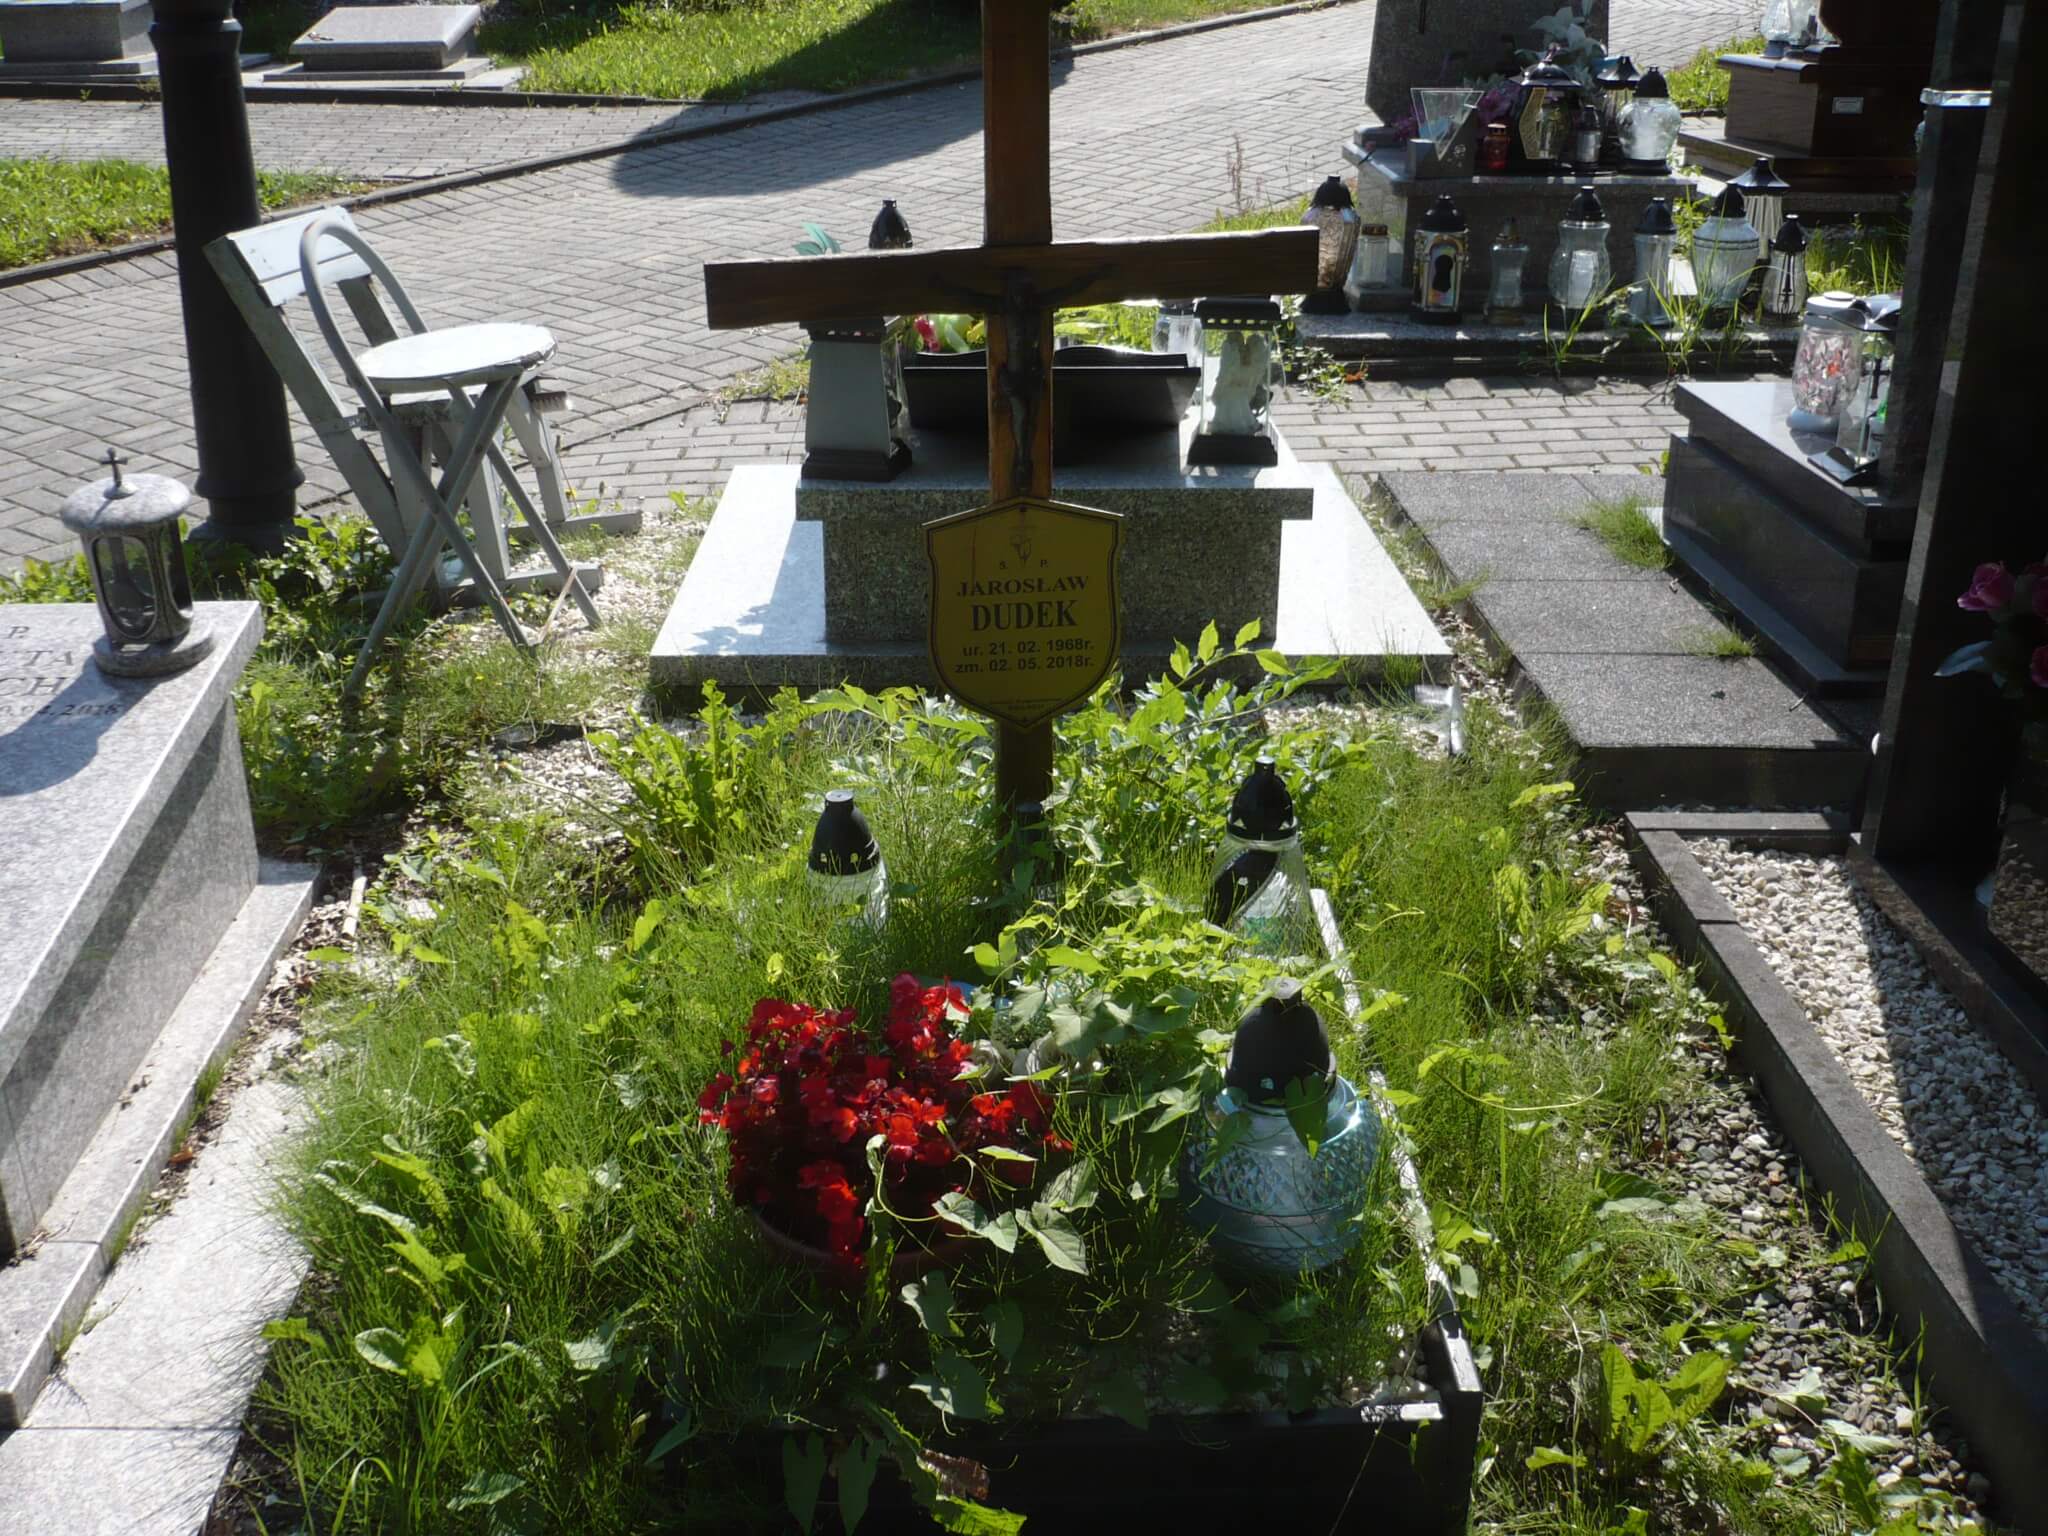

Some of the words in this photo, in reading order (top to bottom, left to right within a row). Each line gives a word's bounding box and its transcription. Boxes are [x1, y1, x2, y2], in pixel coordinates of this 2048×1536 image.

[956, 575, 1089, 597] JAROSŁAW
[970, 599, 1078, 632] DUDEK
[962, 645, 984, 657] ur.
[988, 641, 1012, 656] 21.
[1017, 640, 1041, 654] 02.
[1046, 637, 1095, 652] 1968r.
[954, 663, 984, 674] zm.
[988, 658, 1012, 672] 02.
[1017, 657, 1041, 671] 05.
[1046, 654, 1095, 669] 2018r.
